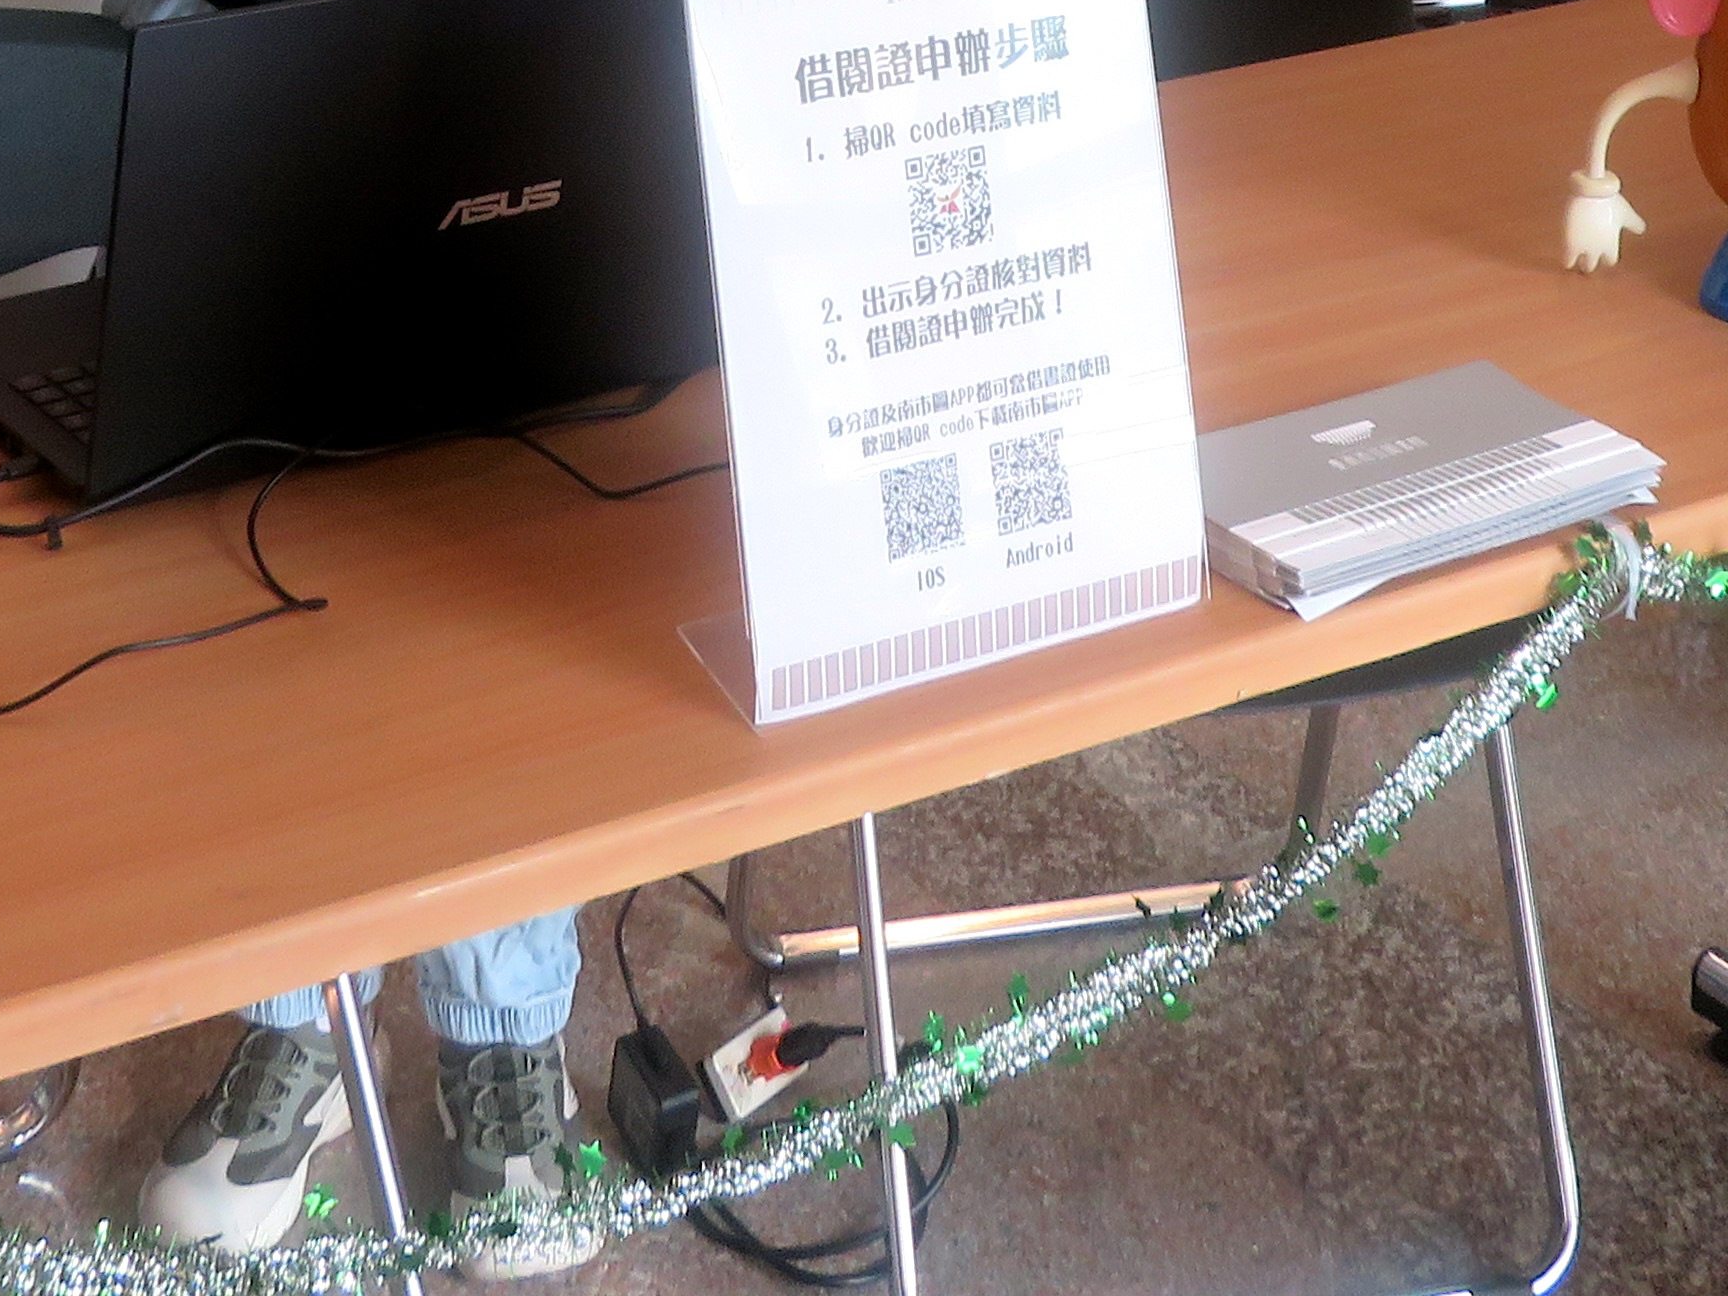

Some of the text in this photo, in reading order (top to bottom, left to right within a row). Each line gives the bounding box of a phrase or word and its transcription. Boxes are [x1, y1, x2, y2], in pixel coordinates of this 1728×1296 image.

[794, 15, 1070, 105] 借閱證申辦步驟
[805, 90, 1062, 164] 1. 掃QR code填寫資料
[437, 179, 563, 231] ASUS
[821, 241, 1093, 325] 2. 出示身分證核對資料
[824, 288, 1063, 365] 3. 借閱證申辦完成！
[1005, 531, 1074, 569] Android
